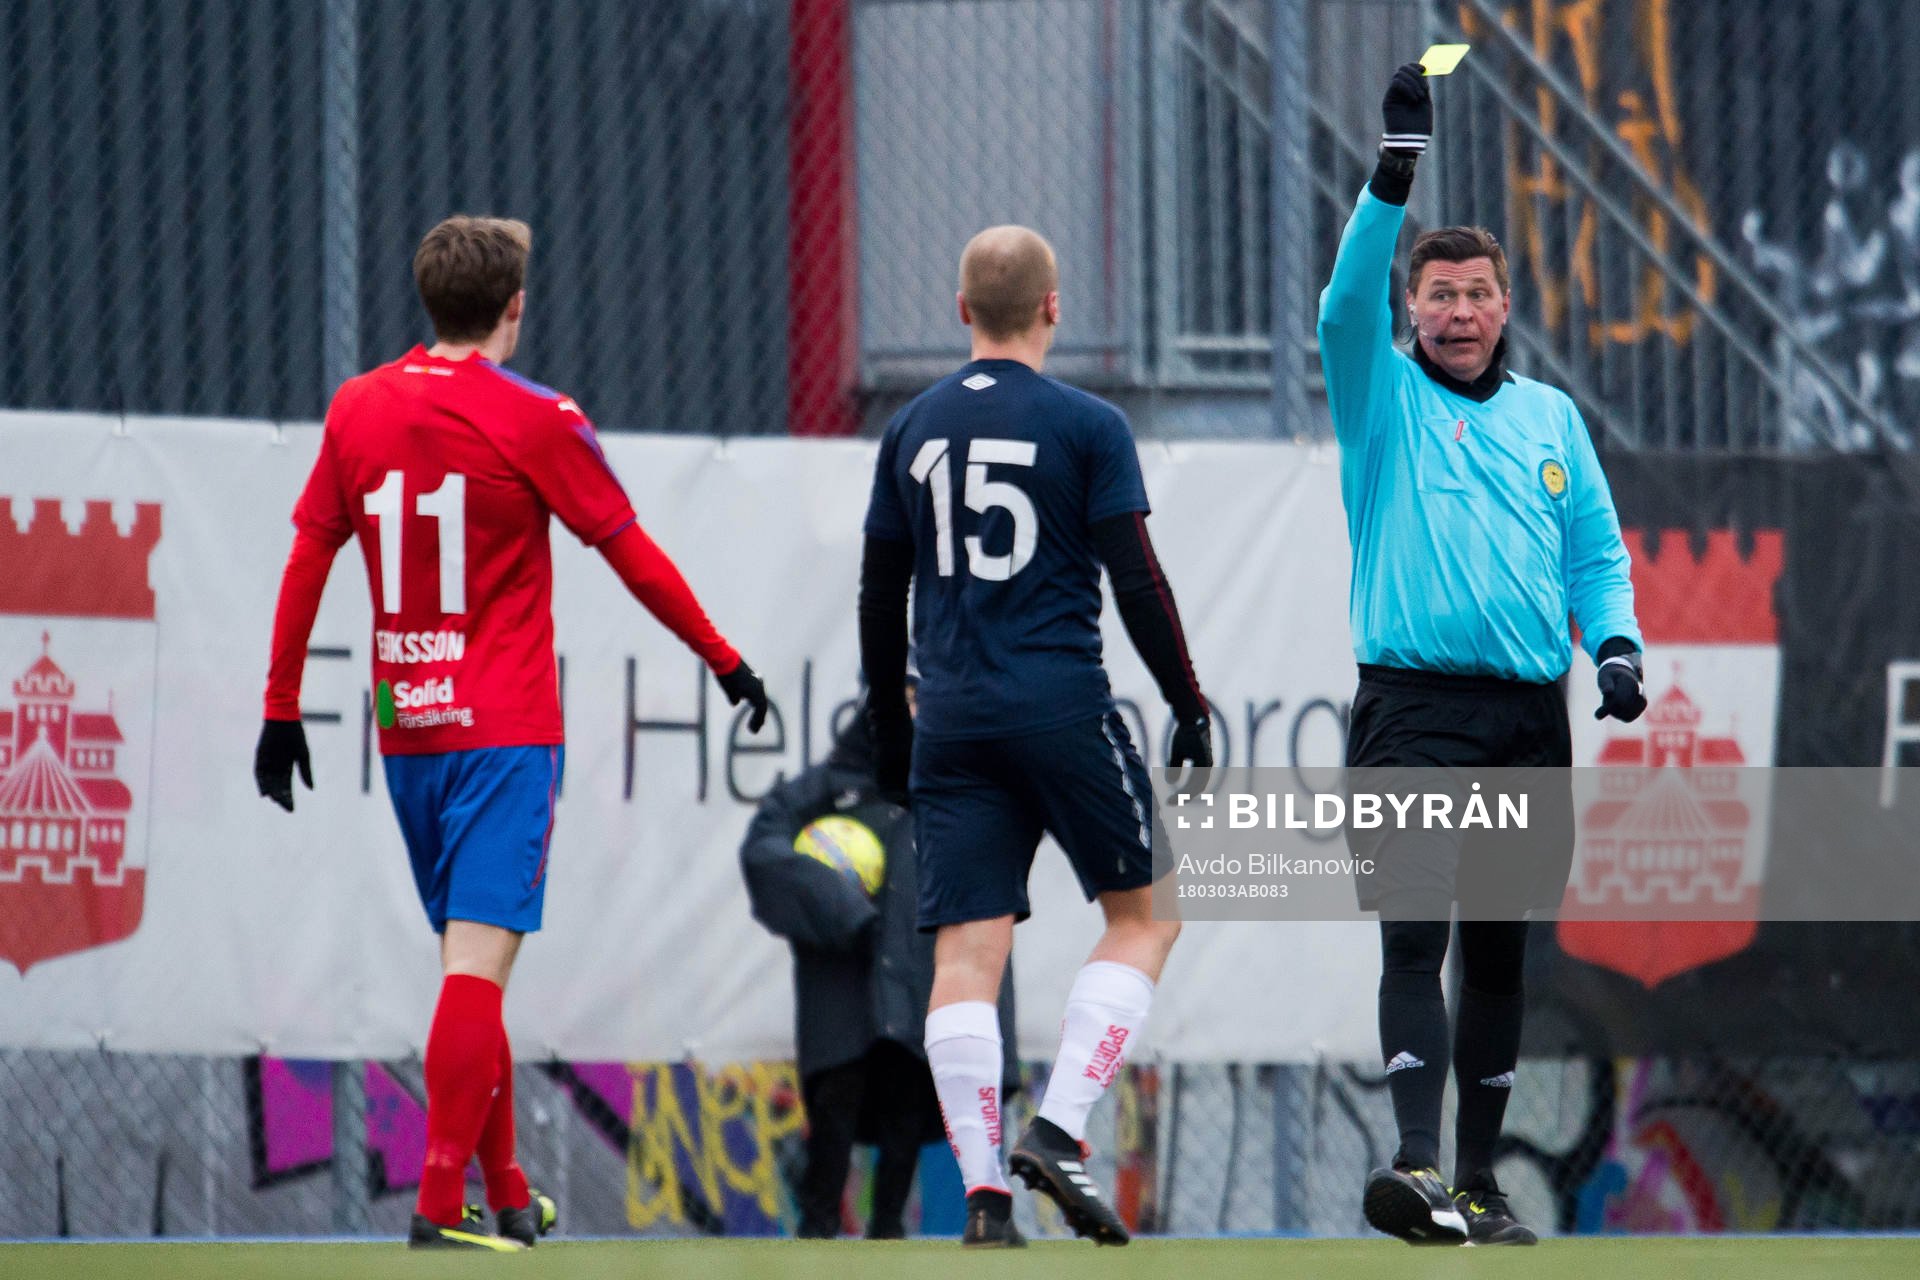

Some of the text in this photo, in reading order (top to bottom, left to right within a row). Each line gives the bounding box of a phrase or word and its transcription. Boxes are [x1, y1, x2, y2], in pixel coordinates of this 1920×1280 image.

[908, 438, 1040, 582] 15
[363, 469, 467, 615] 11
[393, 675, 455, 709] Solid
[1081, 1024, 1129, 1081] SPORTIA
[977, 1086, 1003, 1147] SPORTIA
